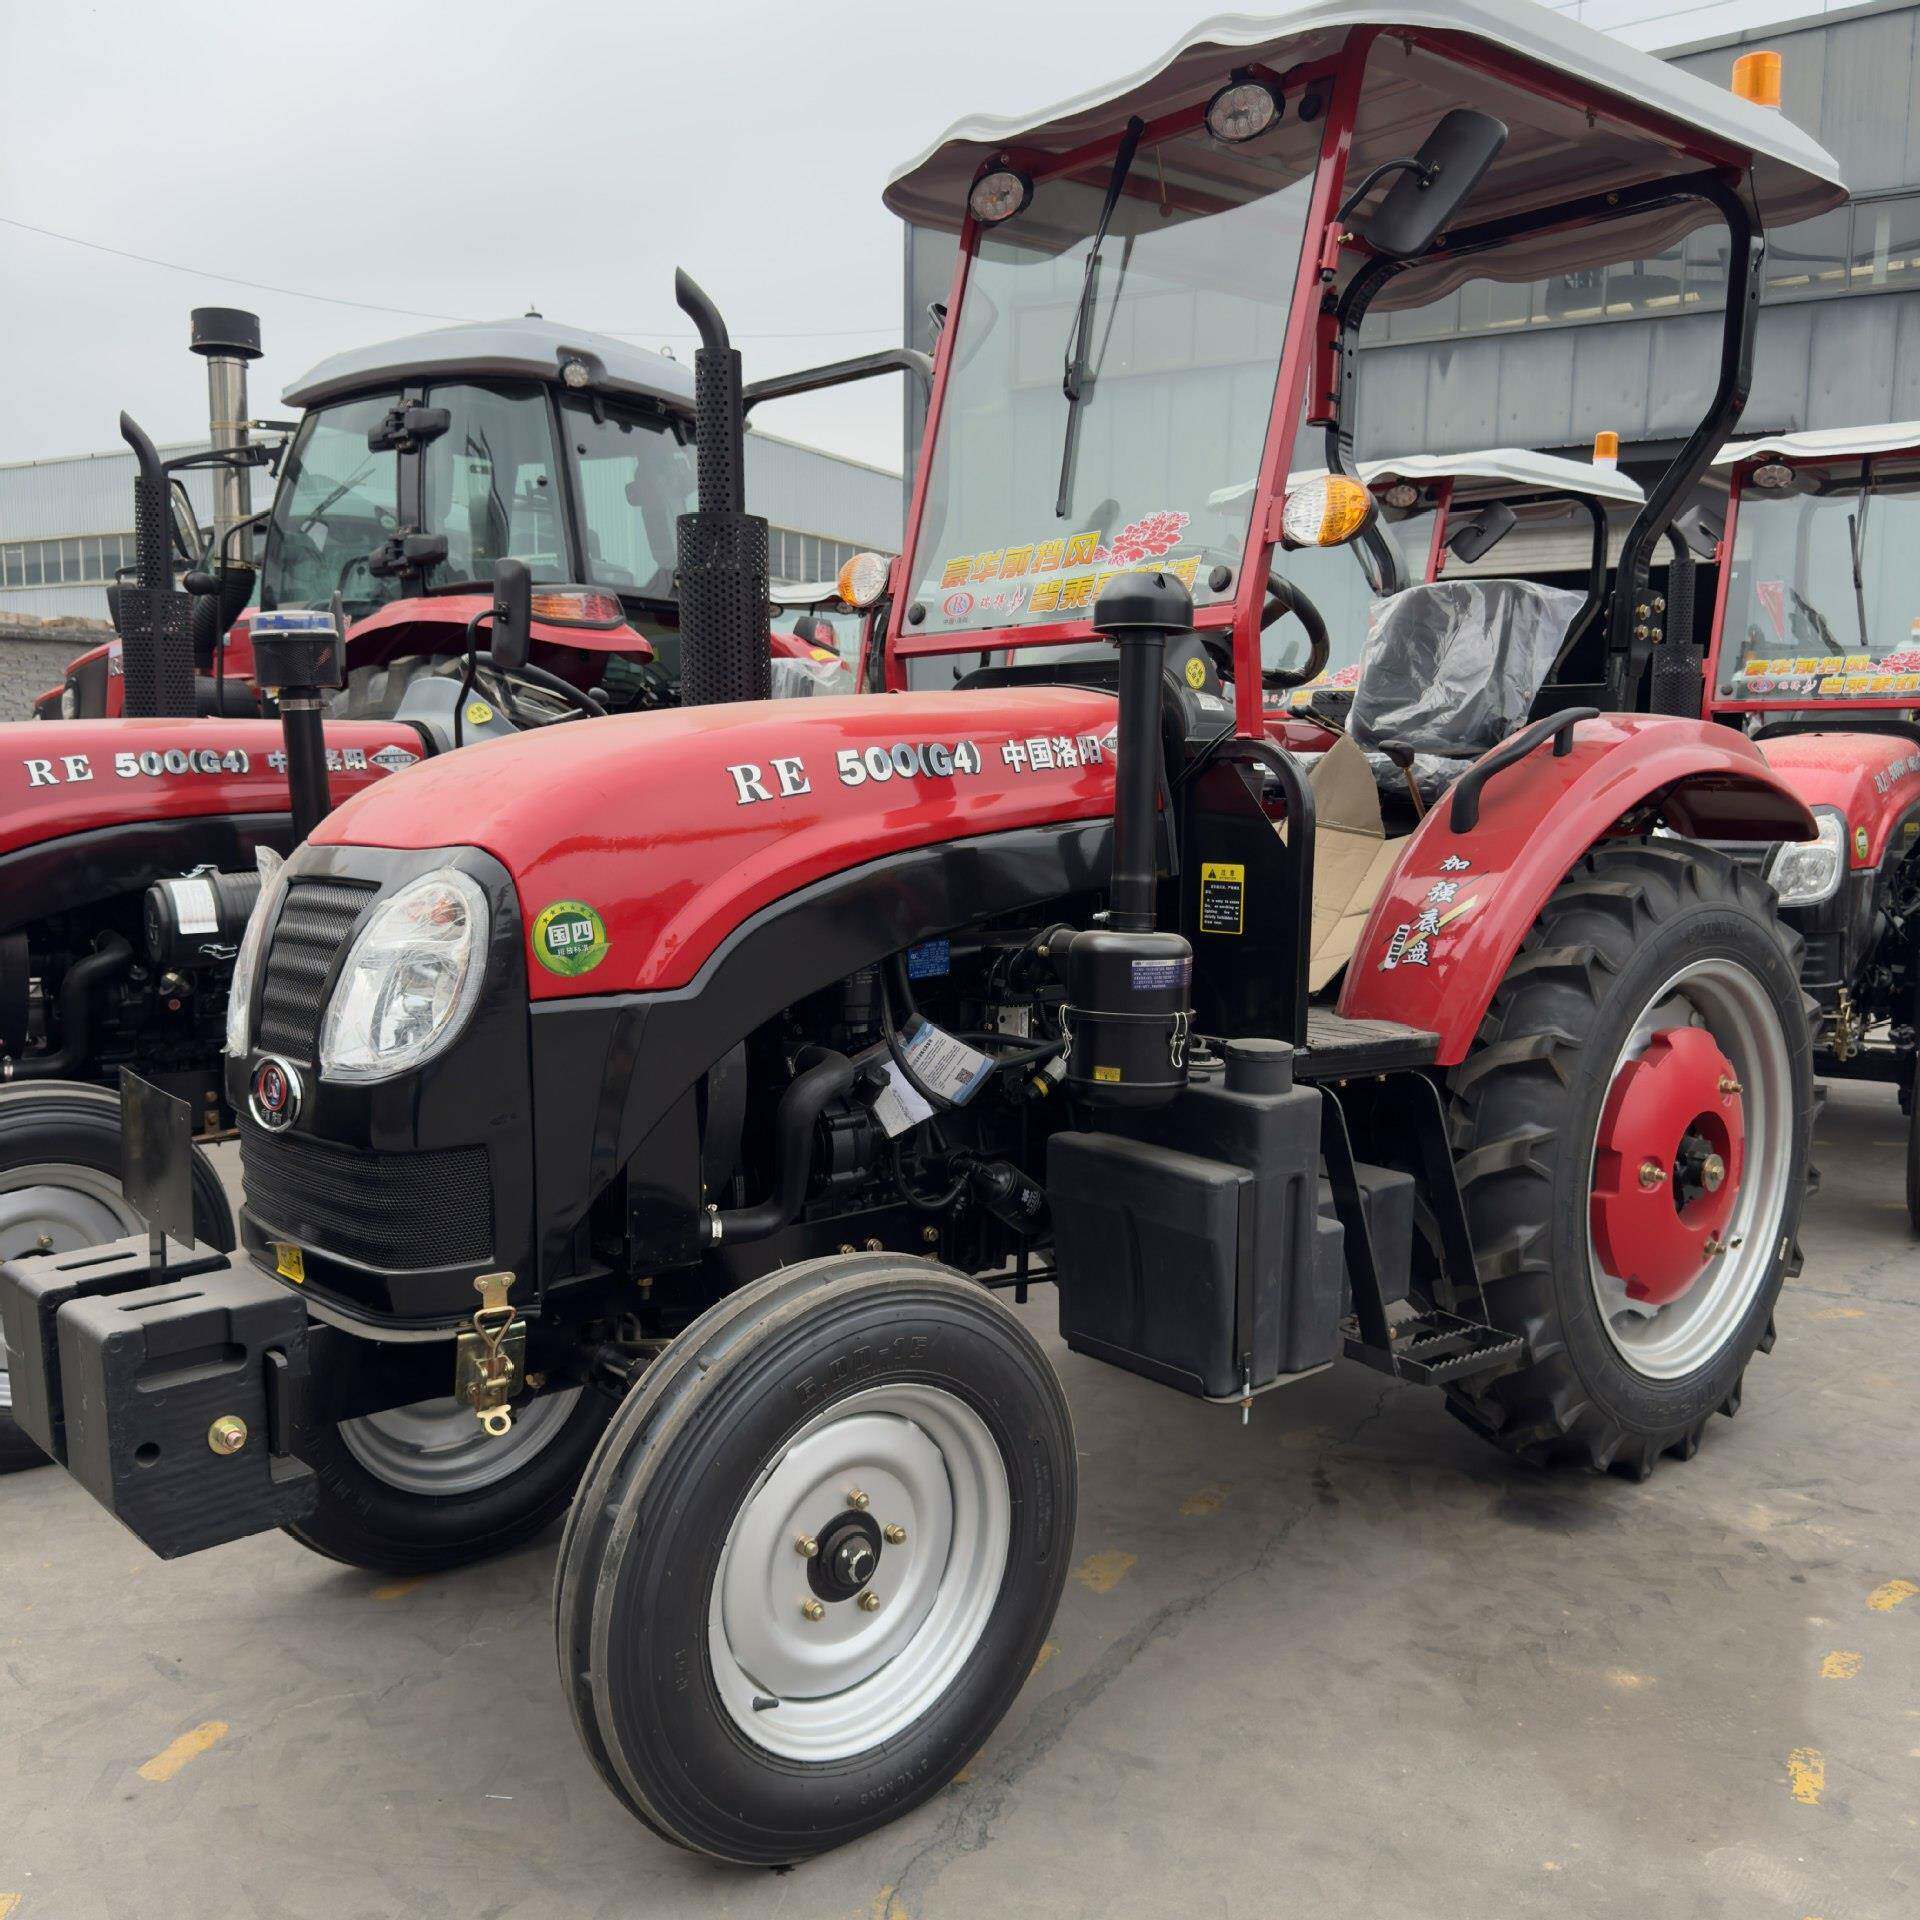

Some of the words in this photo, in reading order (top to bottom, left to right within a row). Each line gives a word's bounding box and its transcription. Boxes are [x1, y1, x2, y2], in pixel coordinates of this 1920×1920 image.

[22, 754, 94, 788] RE
[115, 748, 249, 778] 500(G4)
[726, 756, 813, 805] RE
[836, 741, 983, 786] 500(G4)
[1001, 735, 1103, 774] 中国洛阳
[547, 920, 595, 948] 国四
